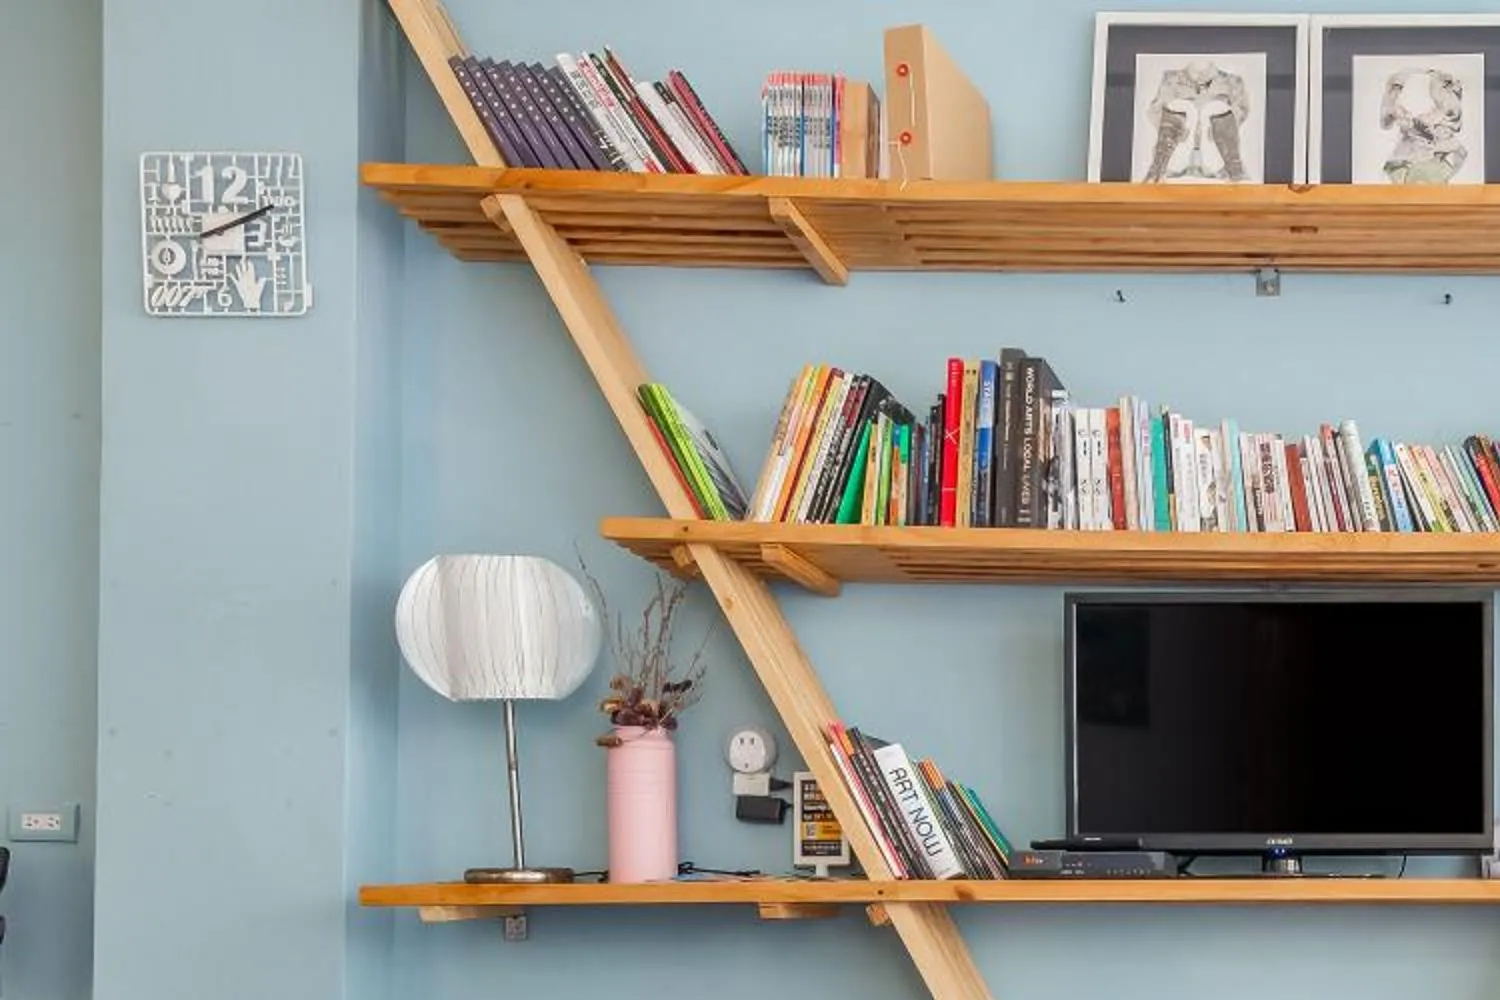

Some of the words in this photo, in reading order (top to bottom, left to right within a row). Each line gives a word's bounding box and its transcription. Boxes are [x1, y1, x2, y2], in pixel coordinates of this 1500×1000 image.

[193, 165, 249, 205] 12
[246, 219, 266, 247] 3
[151, 284, 199, 307] 007
[217, 287, 233, 307] 6
[1025, 367, 1035, 403] WORLD
[1024, 406, 1034, 435] ARTS
[1023, 437, 1033, 473] LOCAL
[889, 767, 918, 804] ART
[909, 806, 942, 857] NOW
